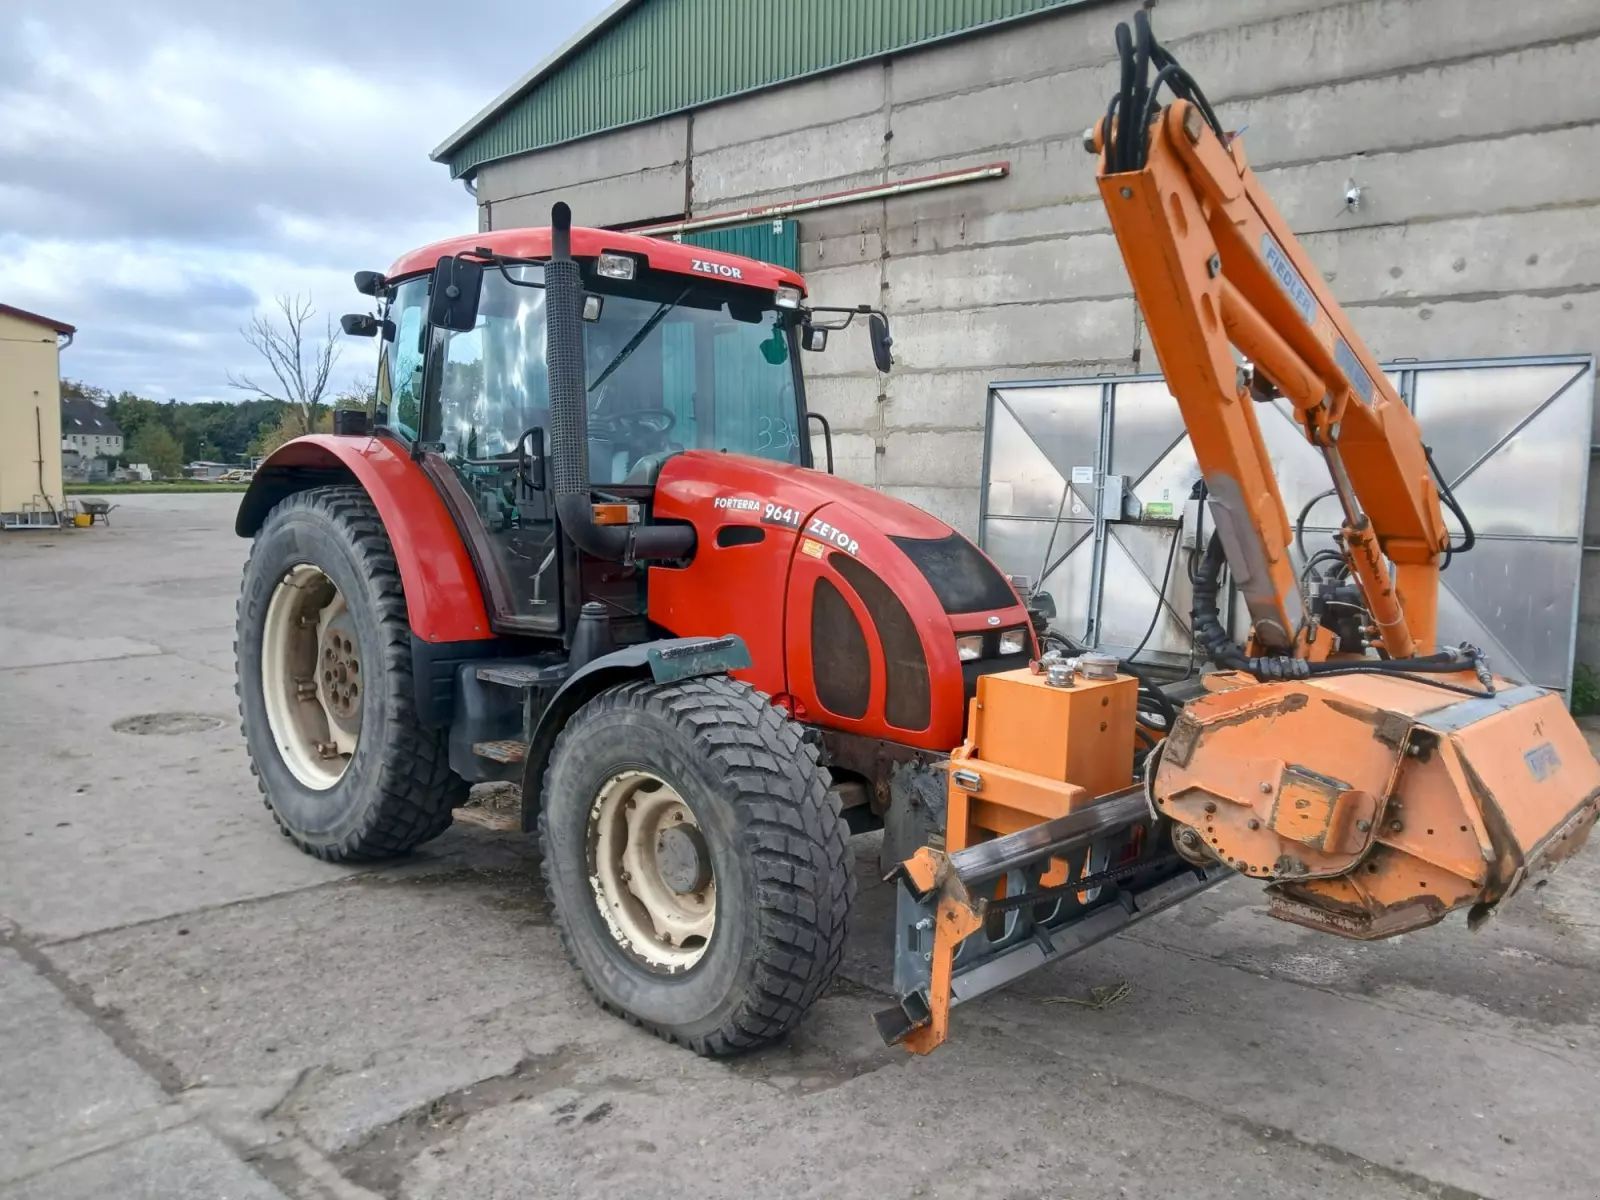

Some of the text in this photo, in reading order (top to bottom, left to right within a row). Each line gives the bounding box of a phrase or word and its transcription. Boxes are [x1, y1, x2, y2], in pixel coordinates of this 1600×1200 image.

[691, 258, 743, 280] ZETOR
[1266, 247, 1312, 314] FIEDLER
[713, 497, 800, 526] FORTERRA 9641
[808, 518, 860, 556] ZETOR
